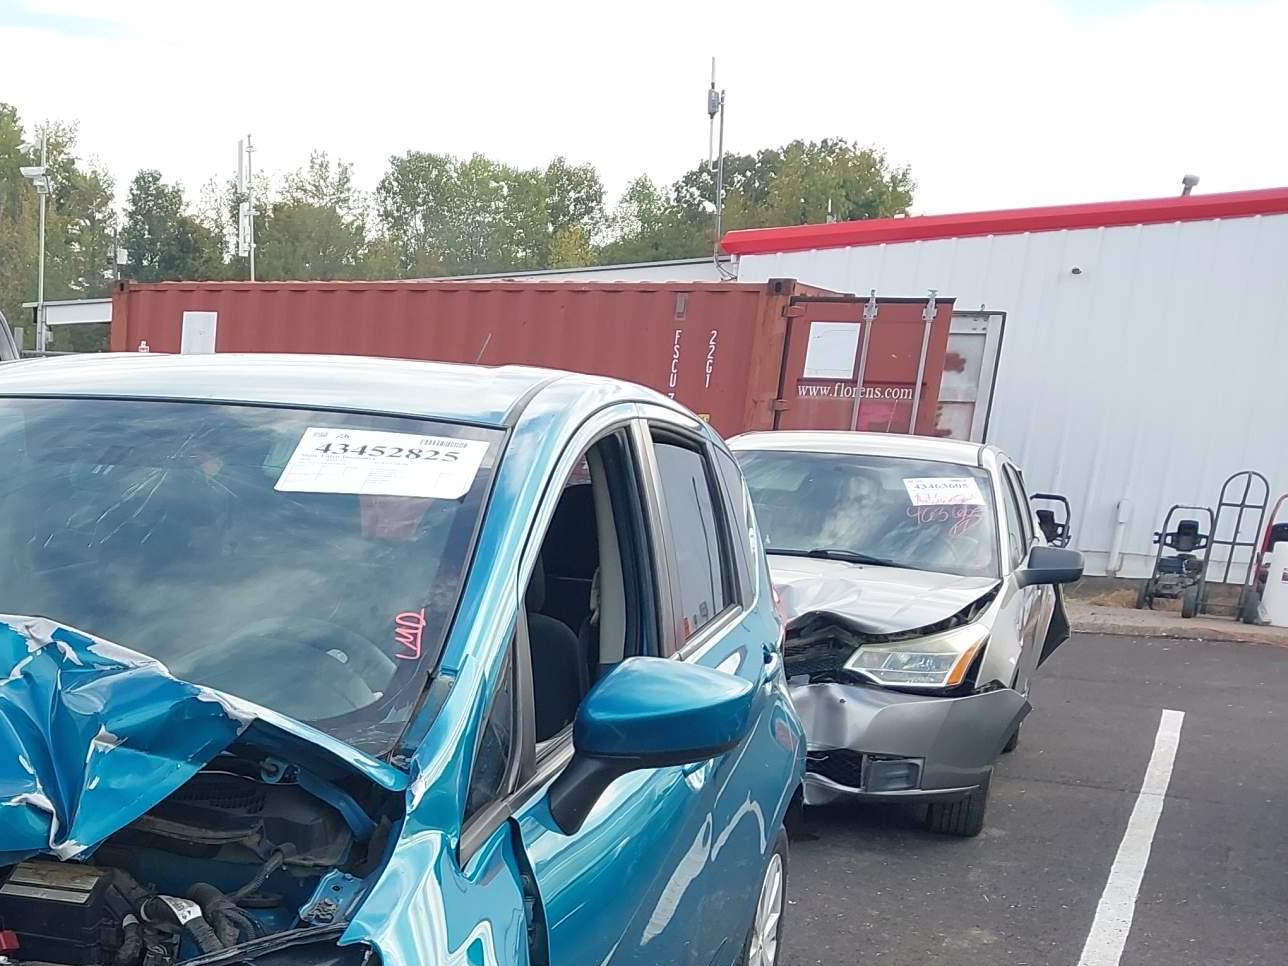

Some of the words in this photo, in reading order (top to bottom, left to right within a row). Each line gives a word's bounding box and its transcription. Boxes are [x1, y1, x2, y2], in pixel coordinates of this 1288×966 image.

[669, 329, 682, 388] FSCU
[705, 330, 718, 388] 22G1
[797, 382, 913, 399] www.florens.com
[314, 442, 461, 463] 43452825
